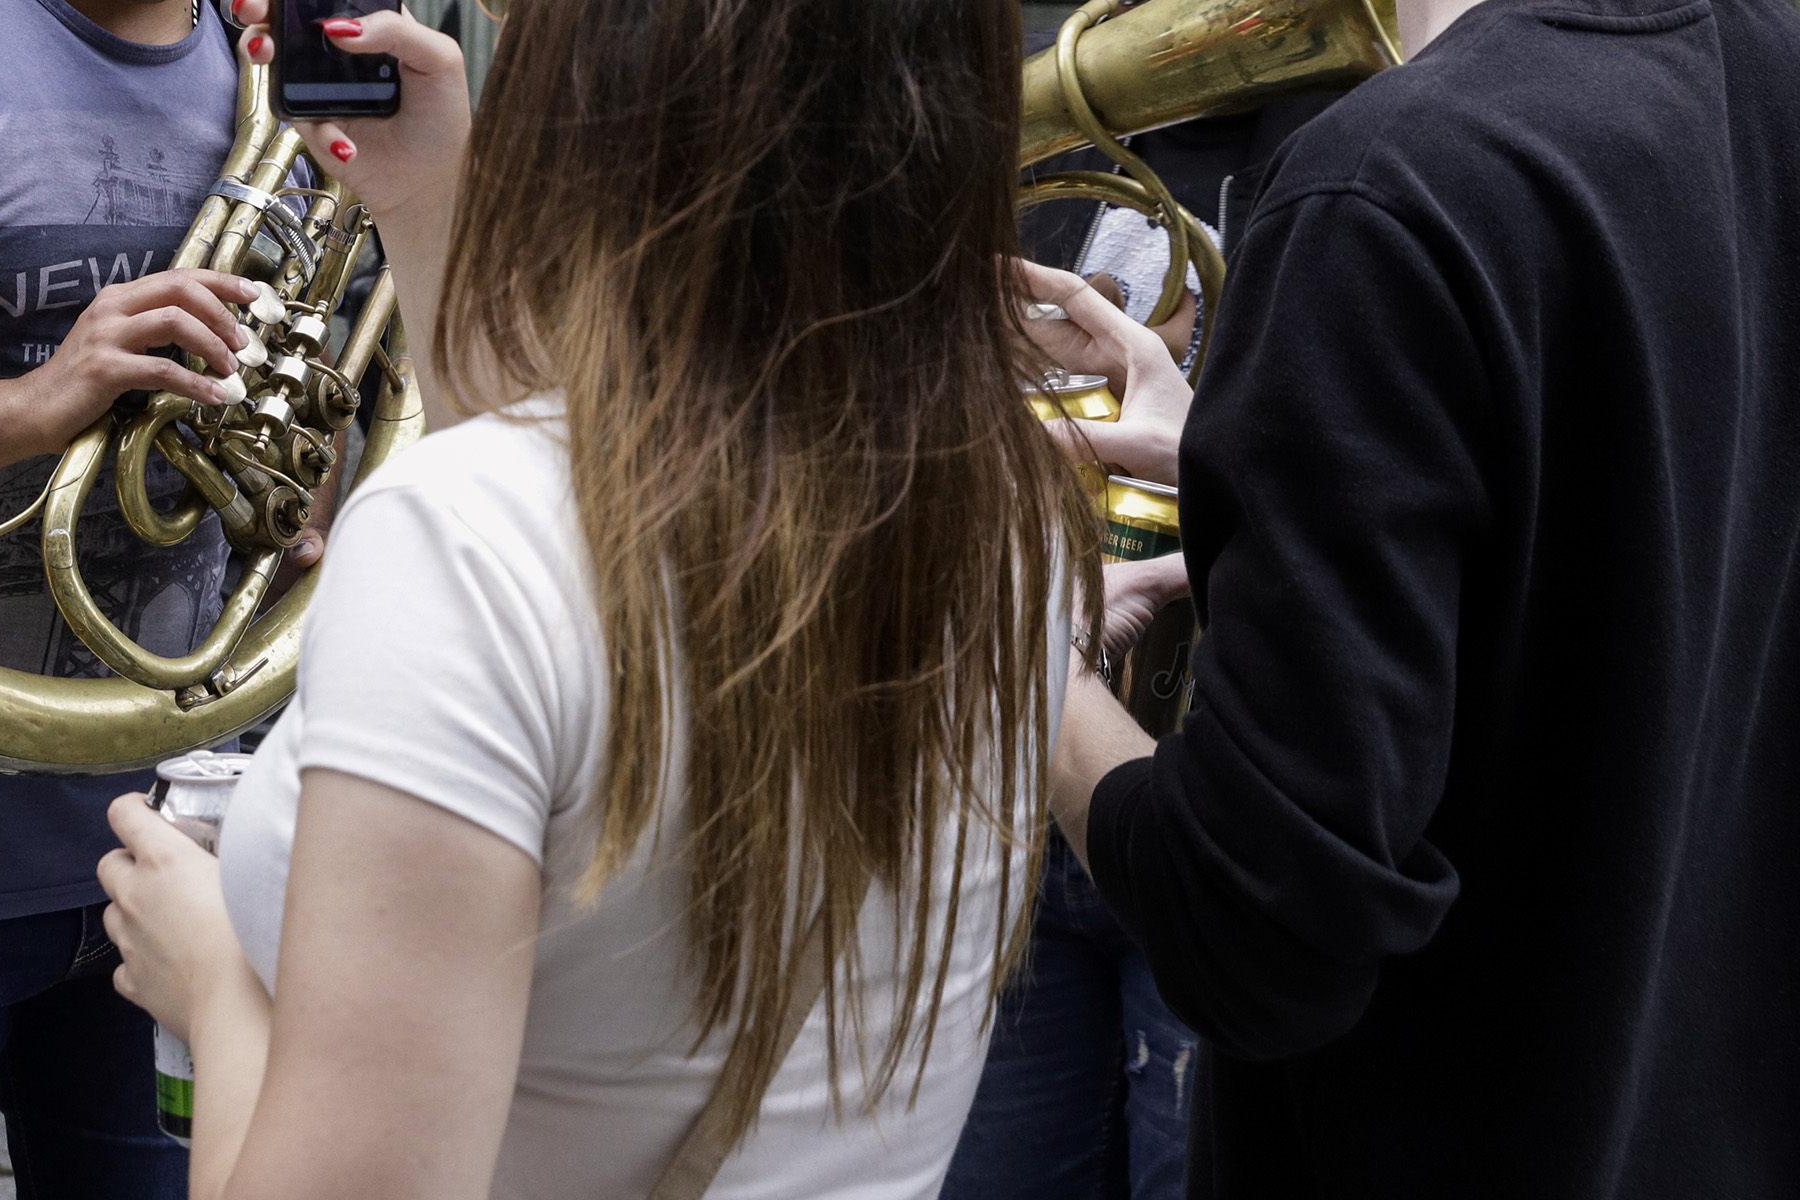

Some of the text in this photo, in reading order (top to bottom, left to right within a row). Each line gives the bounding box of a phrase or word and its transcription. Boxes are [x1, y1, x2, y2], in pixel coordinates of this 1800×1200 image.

[21, 343, 61, 363] TH
[1100, 532, 1143, 553] GER BEER
